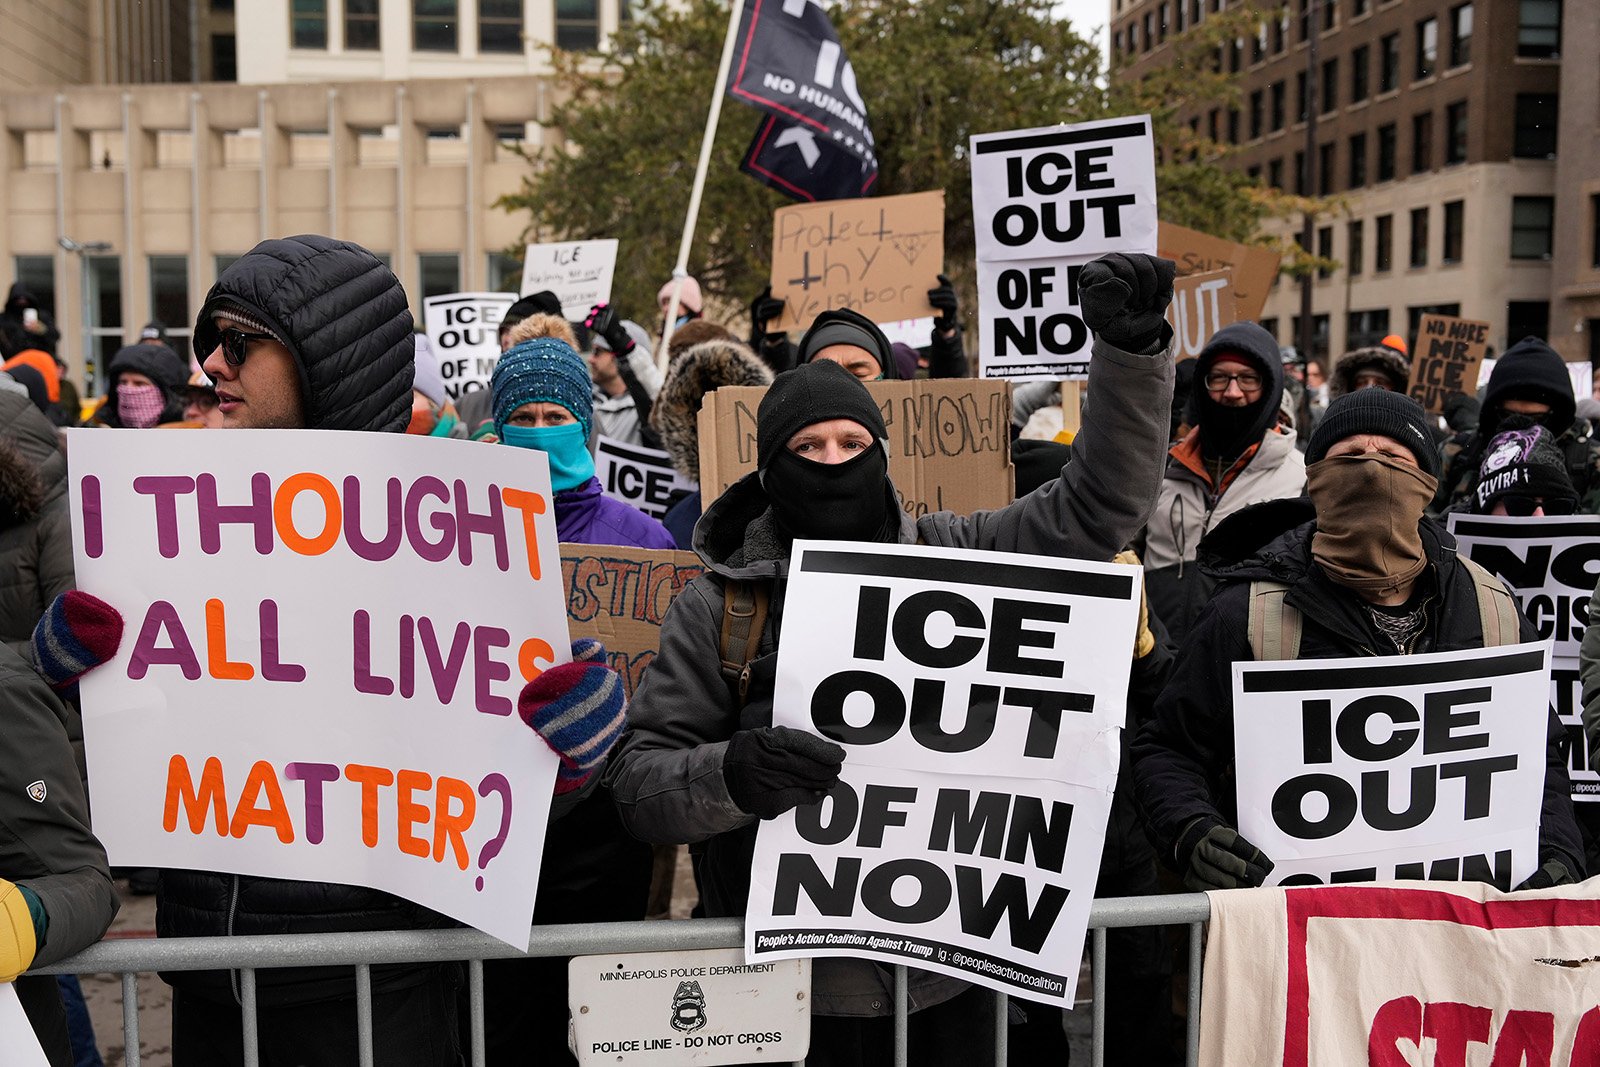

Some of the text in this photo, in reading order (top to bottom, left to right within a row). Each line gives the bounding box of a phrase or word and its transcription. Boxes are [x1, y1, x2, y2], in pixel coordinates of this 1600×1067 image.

[763, 72, 864, 132] NO HUMAN
[1006, 146, 1115, 198] ICE
[779, 208, 892, 252] Protect
[992, 194, 1136, 246] OUT
[554, 246, 581, 265] ICE
[997, 267, 1056, 310] OF
[446, 306, 499, 326] ICE
[994, 313, 1088, 356] NO
[1449, 322, 1489, 344] MORE
[441, 358, 495, 379] OF M
[1417, 358, 1466, 389] ICE
[1429, 339, 1476, 362] MR.
[444, 380, 492, 401] NO
[608, 460, 674, 506] ICE
[1477, 468, 1518, 508] ELVIRA
[81, 472, 546, 580] I THOUGHT
[127, 599, 306, 682] ALL
[853, 585, 1071, 678] ICE
[810, 670, 1095, 759] OUT
[1301, 686, 1492, 764] ICE
[1271, 754, 1518, 839] OUT
[162, 754, 513, 892] MATTER?
[794, 779, 1074, 874] OF MN
[771, 853, 1070, 955] NOW
[600, 963, 776, 981] MINNEAPOLIS POLICE DEPARTMENT
[757, 934, 794, 948] People's
[795, 933, 825, 945] Action
[825, 933, 866, 947] Coalition
[866, 936, 903, 951] Against
[904, 940, 933, 957] Trump
[952, 952, 1063, 992] @peoplesactioncoalition
[592, 1040, 640, 1053] POLICE
[644, 1038, 672, 1051] LINE
[684, 1036, 704, 1048] DO
[707, 1034, 734, 1047] NOT
[737, 1031, 782, 1044] CROSS
